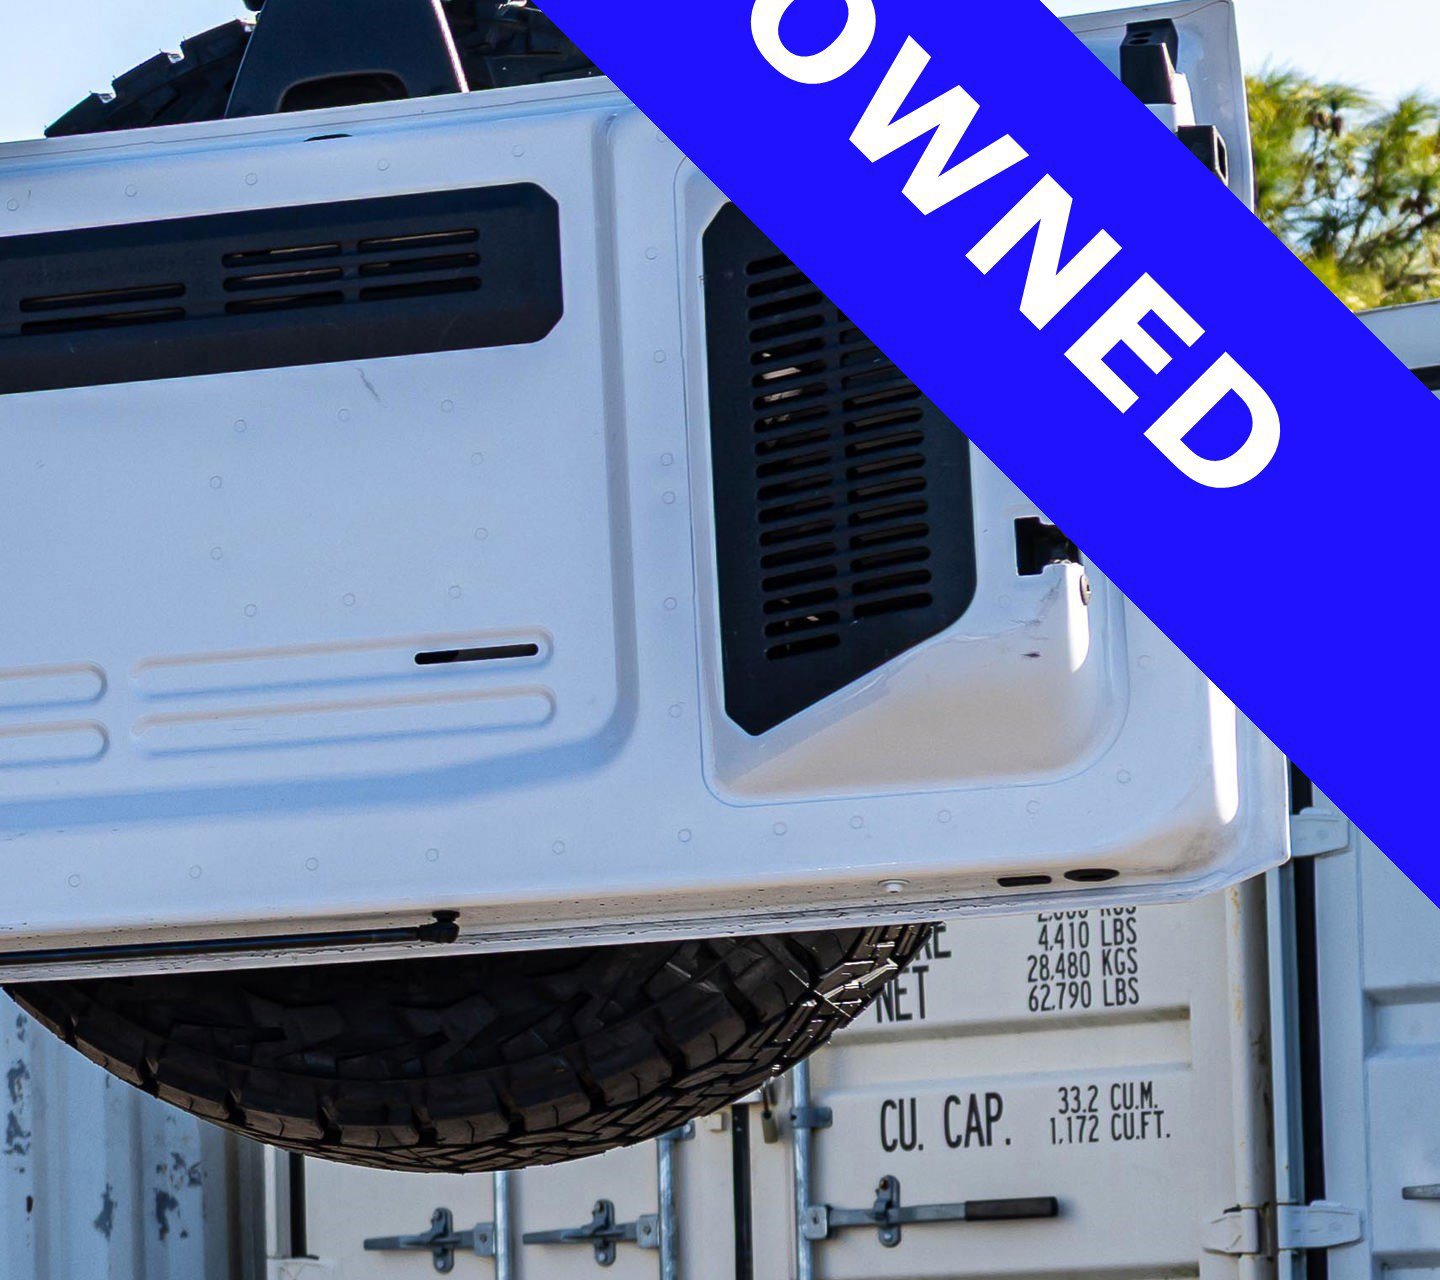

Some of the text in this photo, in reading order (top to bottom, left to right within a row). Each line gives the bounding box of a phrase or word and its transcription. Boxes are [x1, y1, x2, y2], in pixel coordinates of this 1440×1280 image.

[1038, 917, 1137, 952] 4,410 LBS
[1027, 947, 1139, 983] 28,480 KGS
[1103, 977, 1140, 1007] LBS
[1057, 1081, 1159, 1114] 33.2 CU.M.
[880, 1092, 1011, 1152] CU. CAP.
[1050, 1110, 1171, 1145] 1,172 CU.FT.
